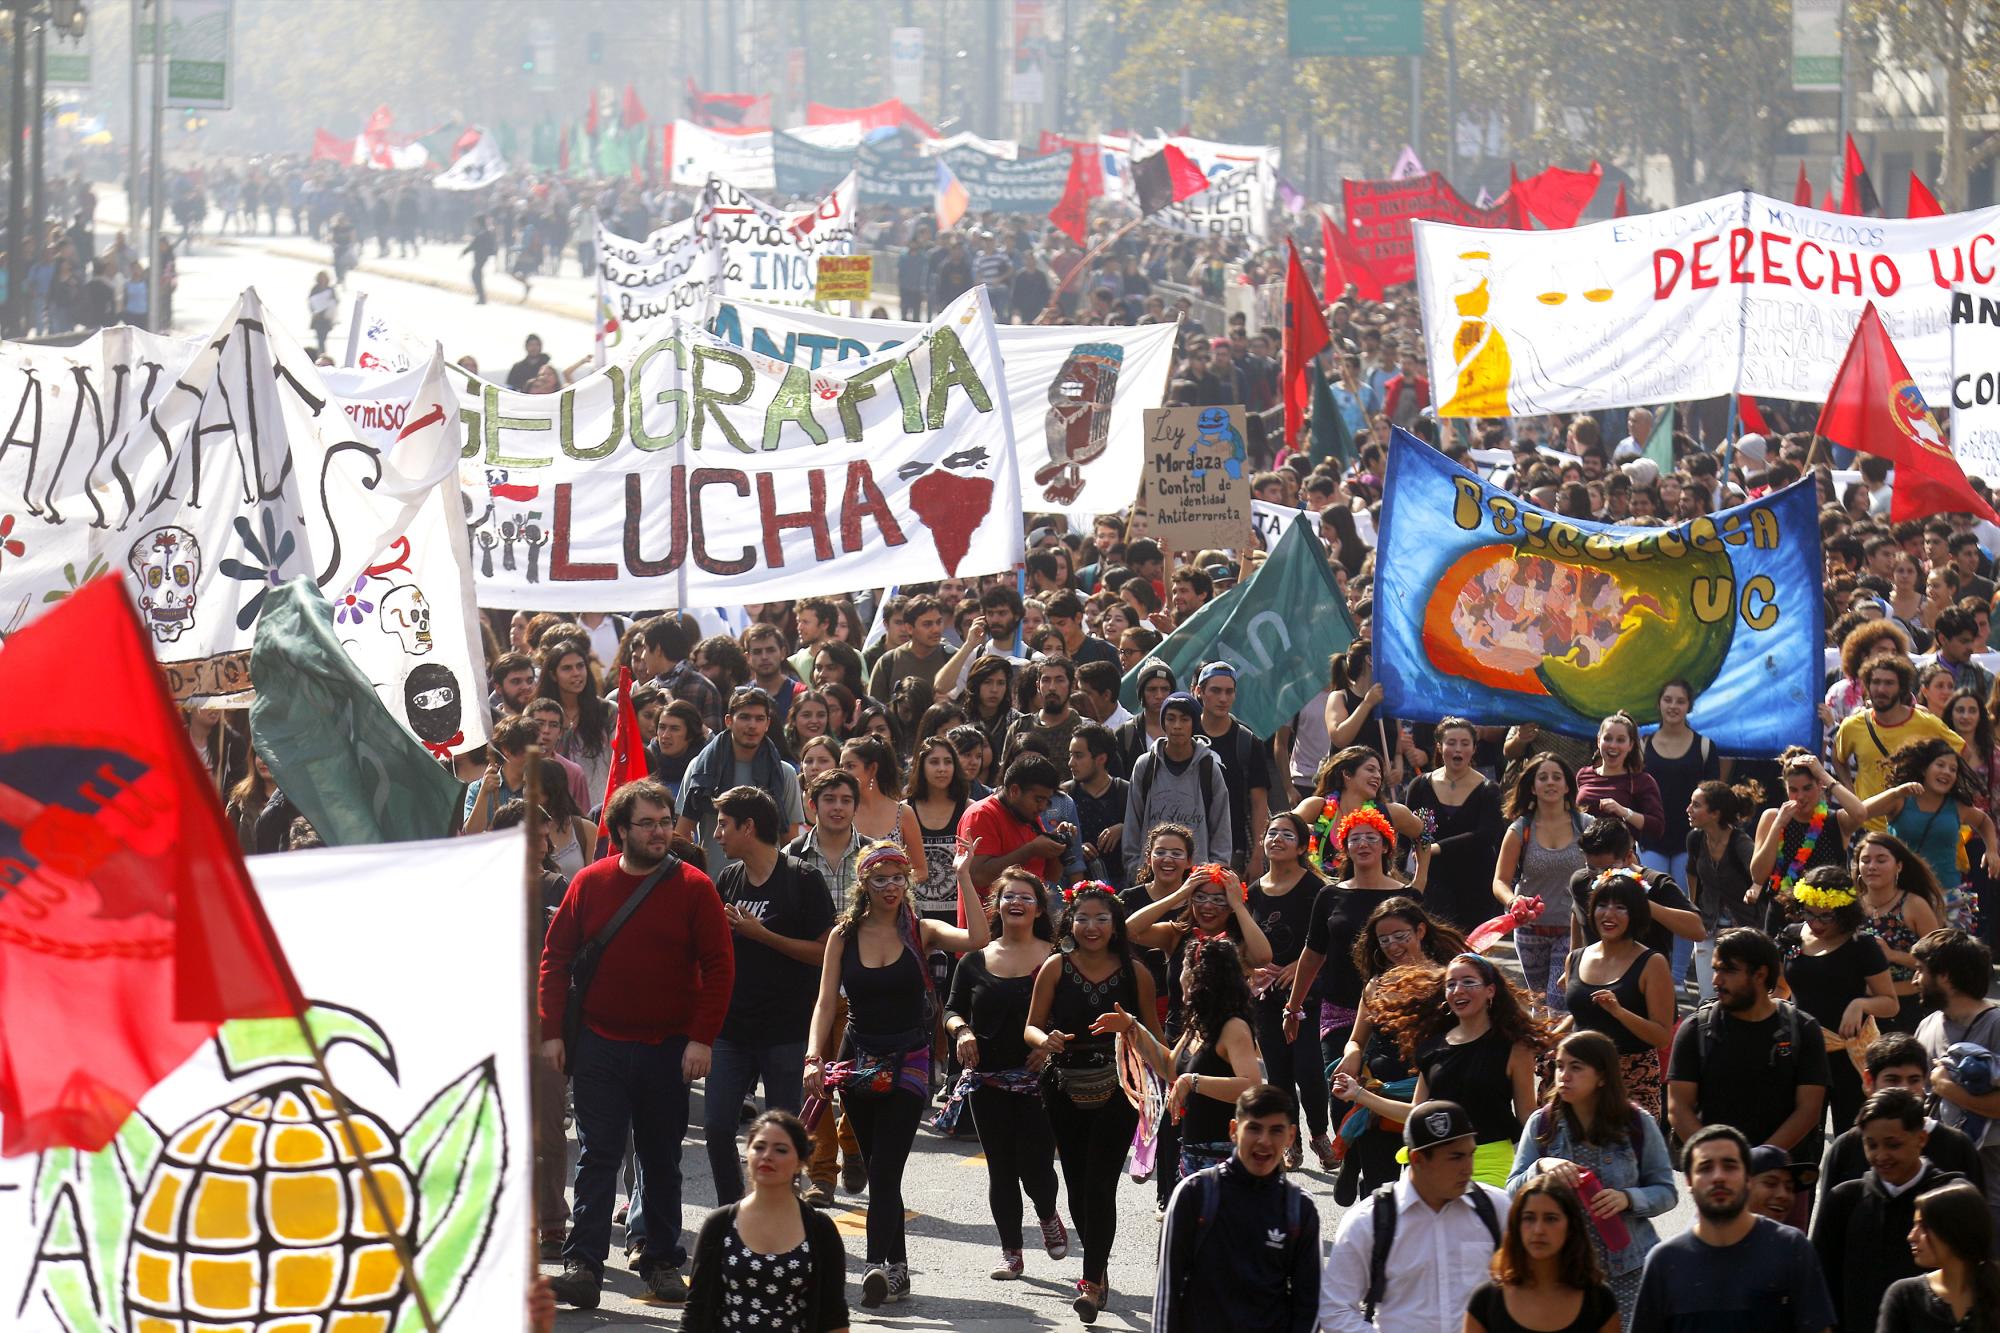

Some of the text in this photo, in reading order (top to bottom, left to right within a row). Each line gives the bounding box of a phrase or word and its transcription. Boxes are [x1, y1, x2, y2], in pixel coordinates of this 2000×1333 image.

[1768, 208, 1885, 247] MOVILIZADOS
[1652, 228, 1997, 301] DERECHO UC
[704, 303, 905, 371] ANT
[1152, 410, 1186, 450] Ley
[1180, 494, 1226, 507] identidad
[1219, 479, 1231, 491] de
[549, 459, 908, 582] LUCHA
[1689, 575, 1780, 631] UC
[735, 899, 770, 920] NIKE
